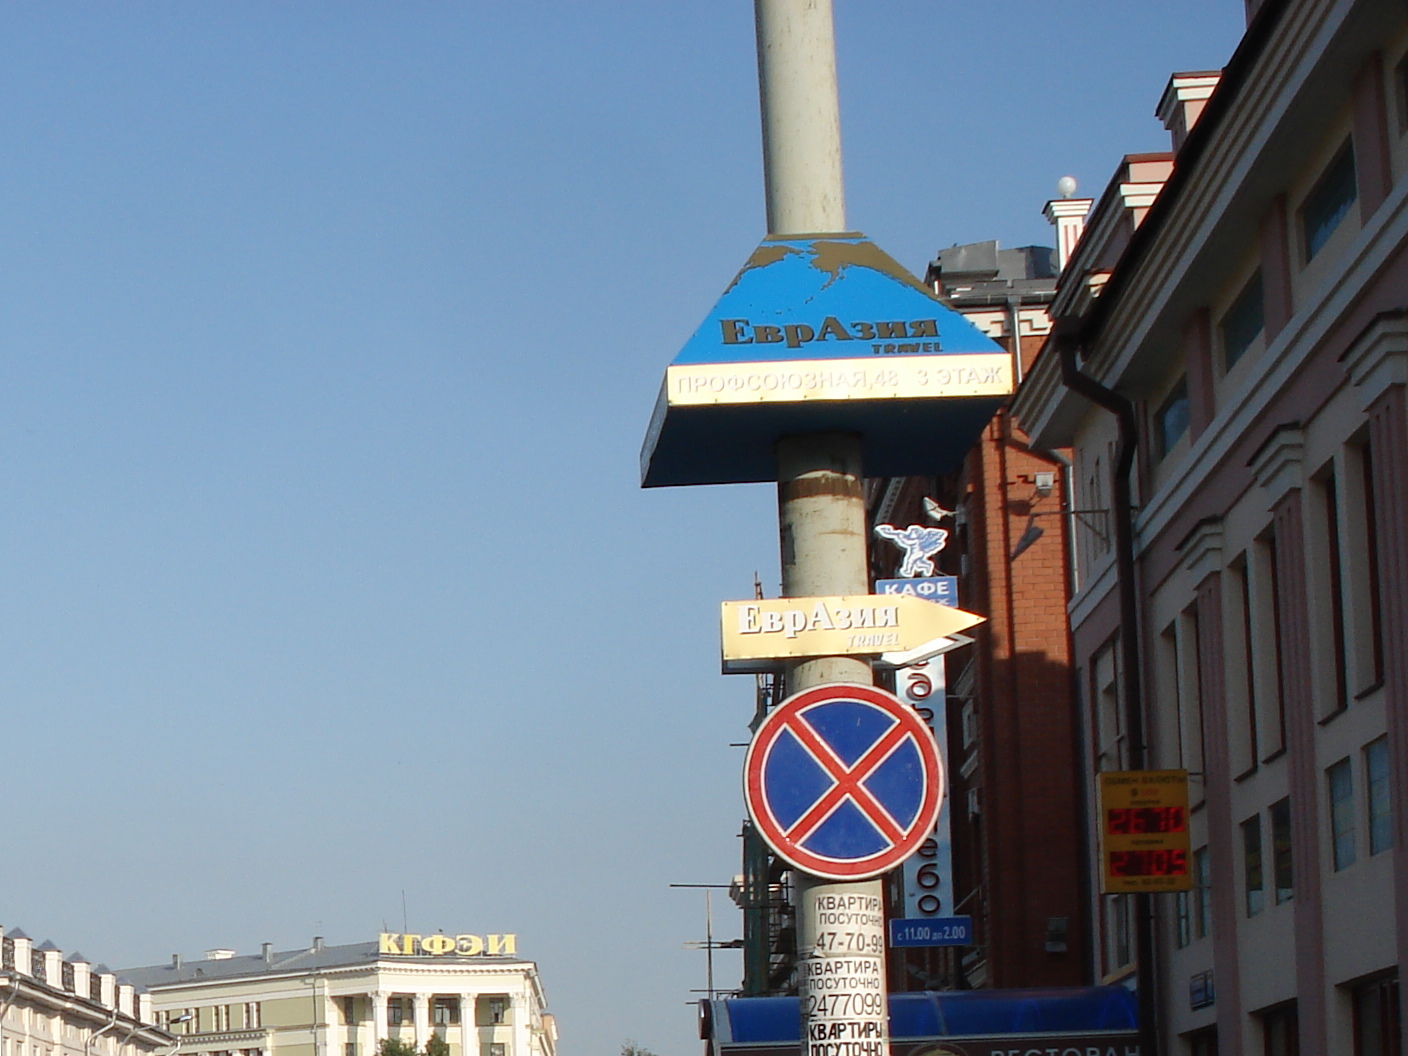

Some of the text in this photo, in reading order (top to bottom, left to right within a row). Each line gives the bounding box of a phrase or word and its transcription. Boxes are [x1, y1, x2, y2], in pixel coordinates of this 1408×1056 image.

[720, 317, 939, 348] ЕврАзия
[871, 341, 944, 354] TRAVEL
[885, 581, 950, 596] КАФЕ
[737, 601, 900, 639] ЕврАзия
[848, 633, 901, 648] TRAVEL
[943, 925, 966, 940] 2.00
[379, 933, 518, 956] КГФЭИ
[807, 960, 879, 977] КВАРТИРА
[809, 976, 880, 990] ПОСУТОЧНО
[809, 992, 883, 1017] 2477099
[809, 1021, 883, 1041] КВАРТИРЫ
